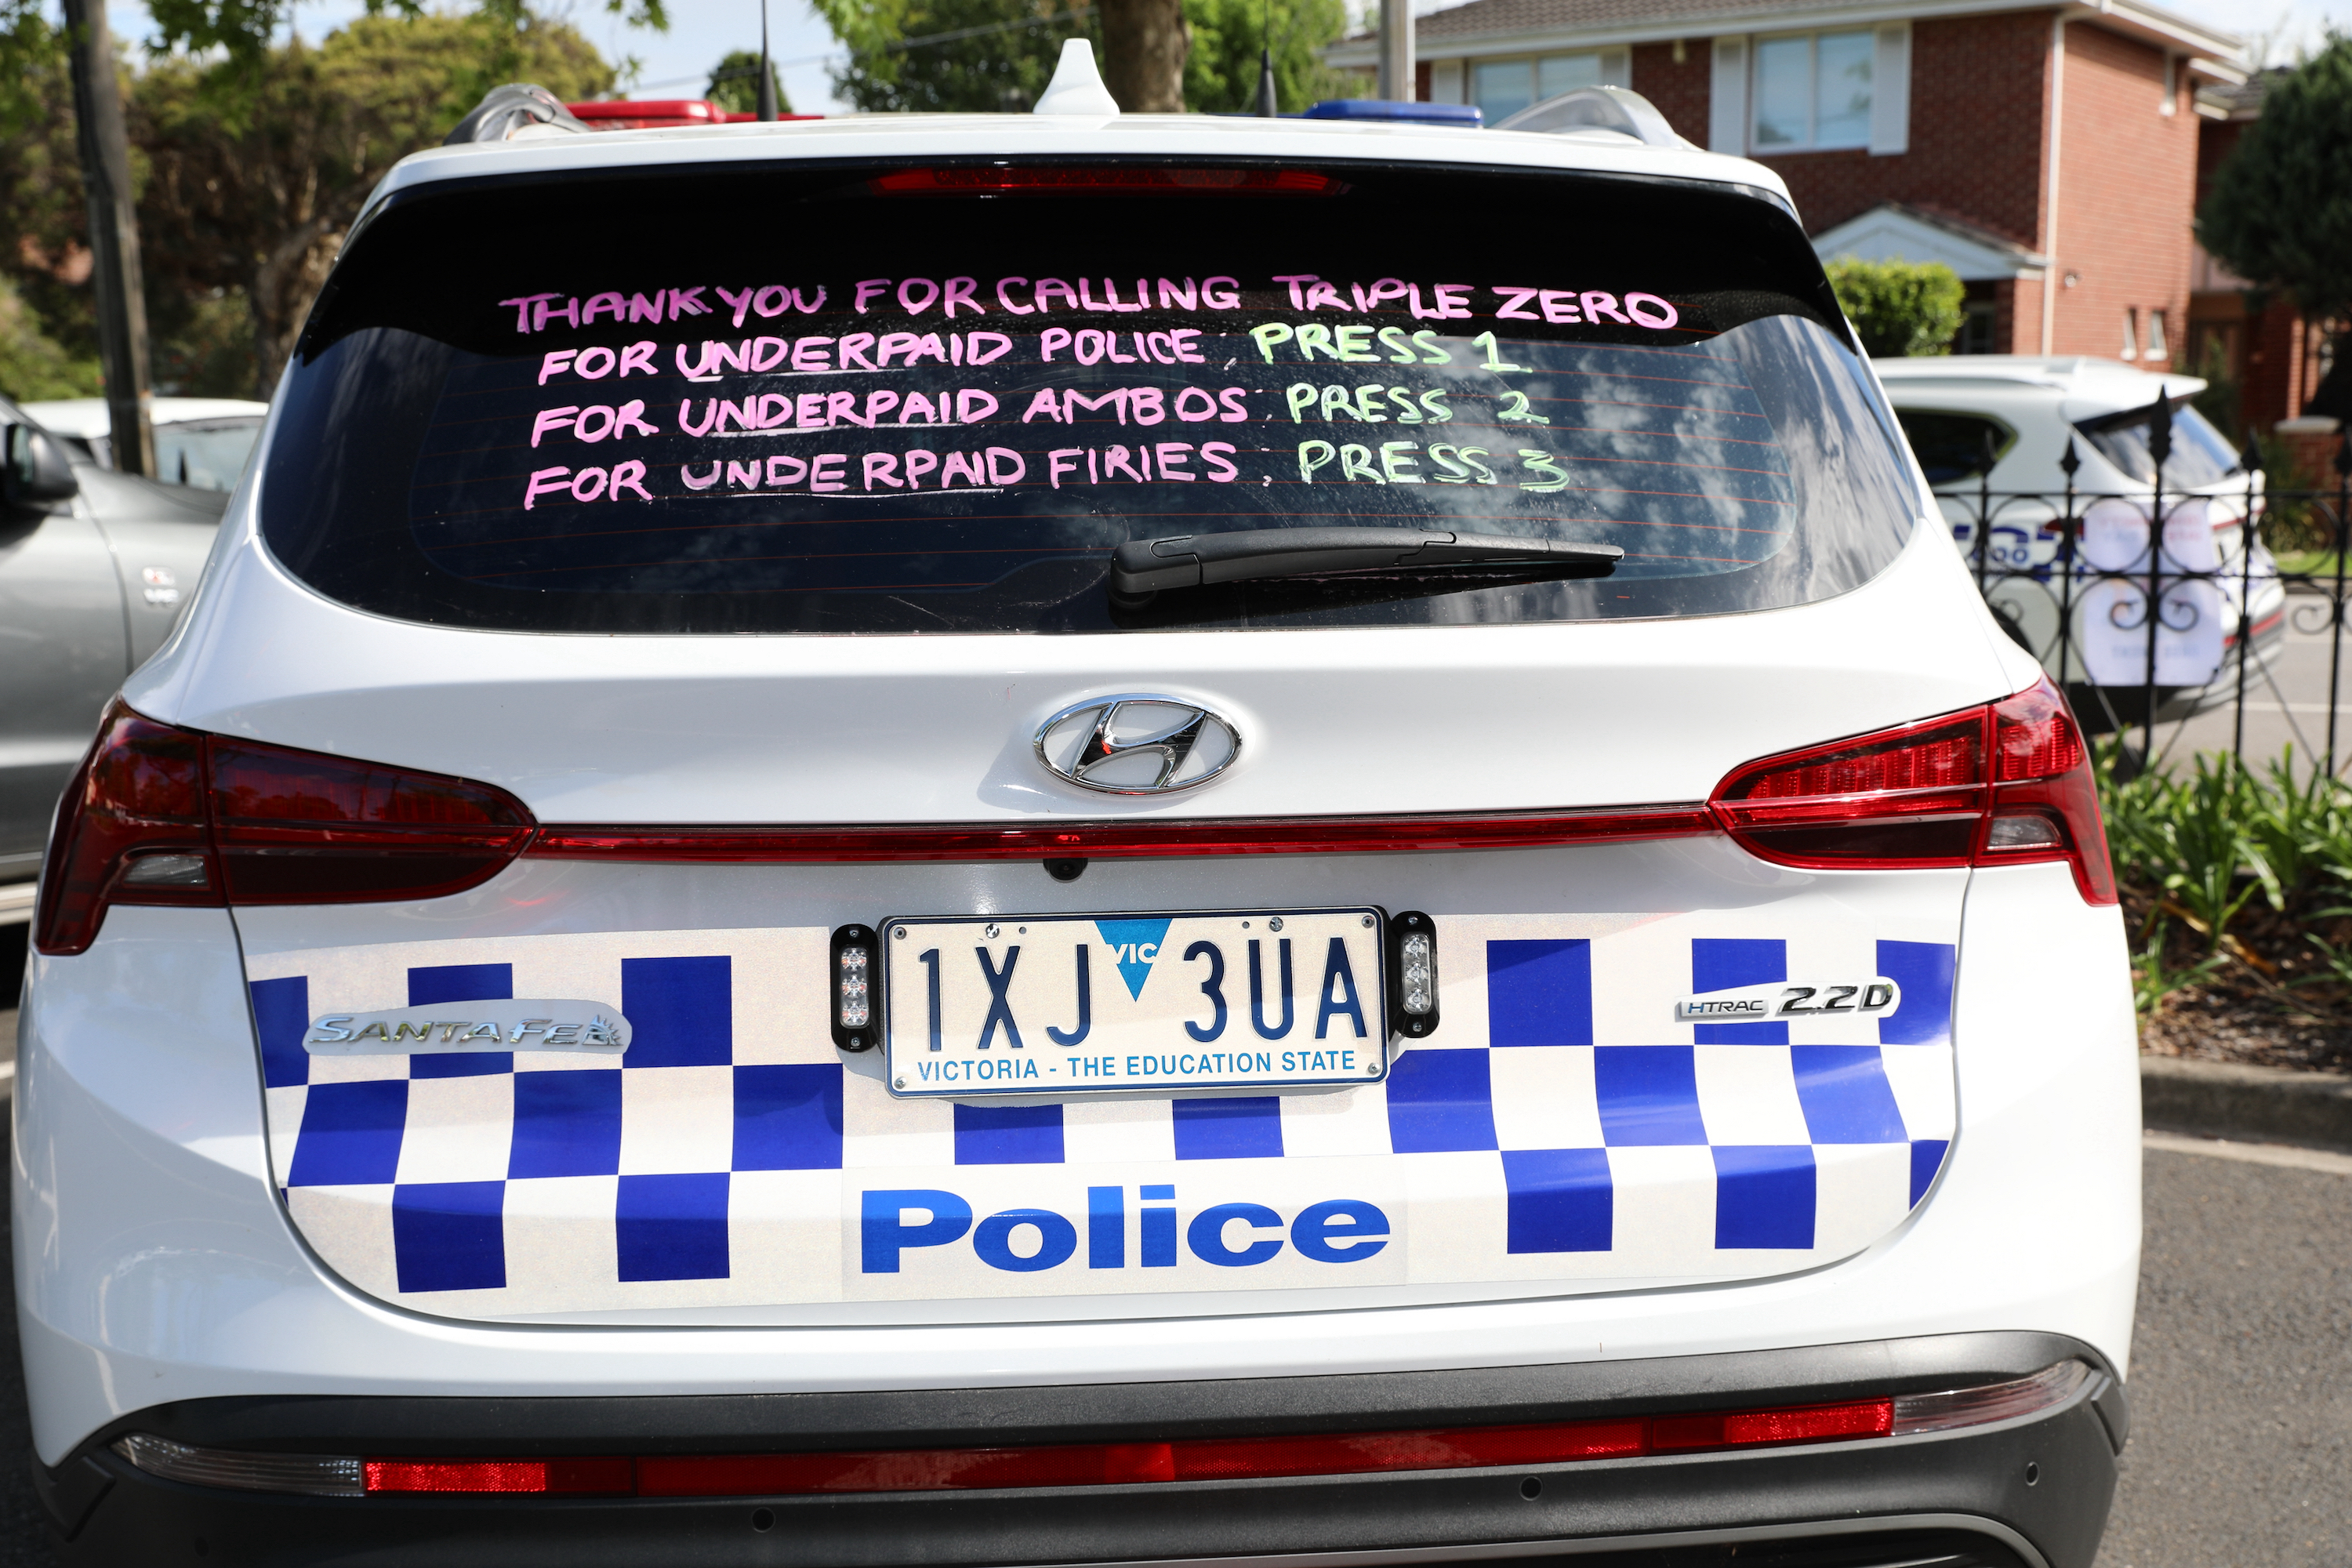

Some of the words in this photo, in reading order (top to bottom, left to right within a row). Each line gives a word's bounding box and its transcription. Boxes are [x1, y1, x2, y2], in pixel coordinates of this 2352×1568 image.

[715, 285, 826, 328] YOU
[854, 277, 987, 319] FOR
[995, 276, 1242, 315] CALLING
[1271, 274, 1475, 320] TRIPLE
[1490, 286, 1679, 330] ZERO
[536, 340, 660, 385] FOR
[674, 331, 1014, 379] UNDERPAID
[1247, 322, 1452, 365] PRESS
[1470, 331, 1534, 373] 1
[529, 401, 661, 448] FOR
[677, 388, 1000, 437] UNDERPAID
[1285, 386, 1454, 424] PRESS
[1497, 390, 1552, 424] 2
[523, 459, 655, 511] FOR
[682, 446, 1026, 492] UNDERPAID
[1297, 440, 1496, 485] PRESS
[1517, 448, 1570, 491] 3
[1105, 942, 1159, 964] VIC
[917, 942, 1093, 1052] 1XJ
[1181, 937, 1368, 1044] 3UA
[1687, 1000, 1764, 1014] HTRAC
[1779, 983, 1893, 1013] 2.2D
[916, 1059, 1039, 1082] VICTORIA
[1067, 1056, 1117, 1076] THE
[1126, 1052, 1270, 1075] EDUCATION
[1280, 1049, 1356, 1072] STATE
[861, 1184, 1391, 1273] Police
